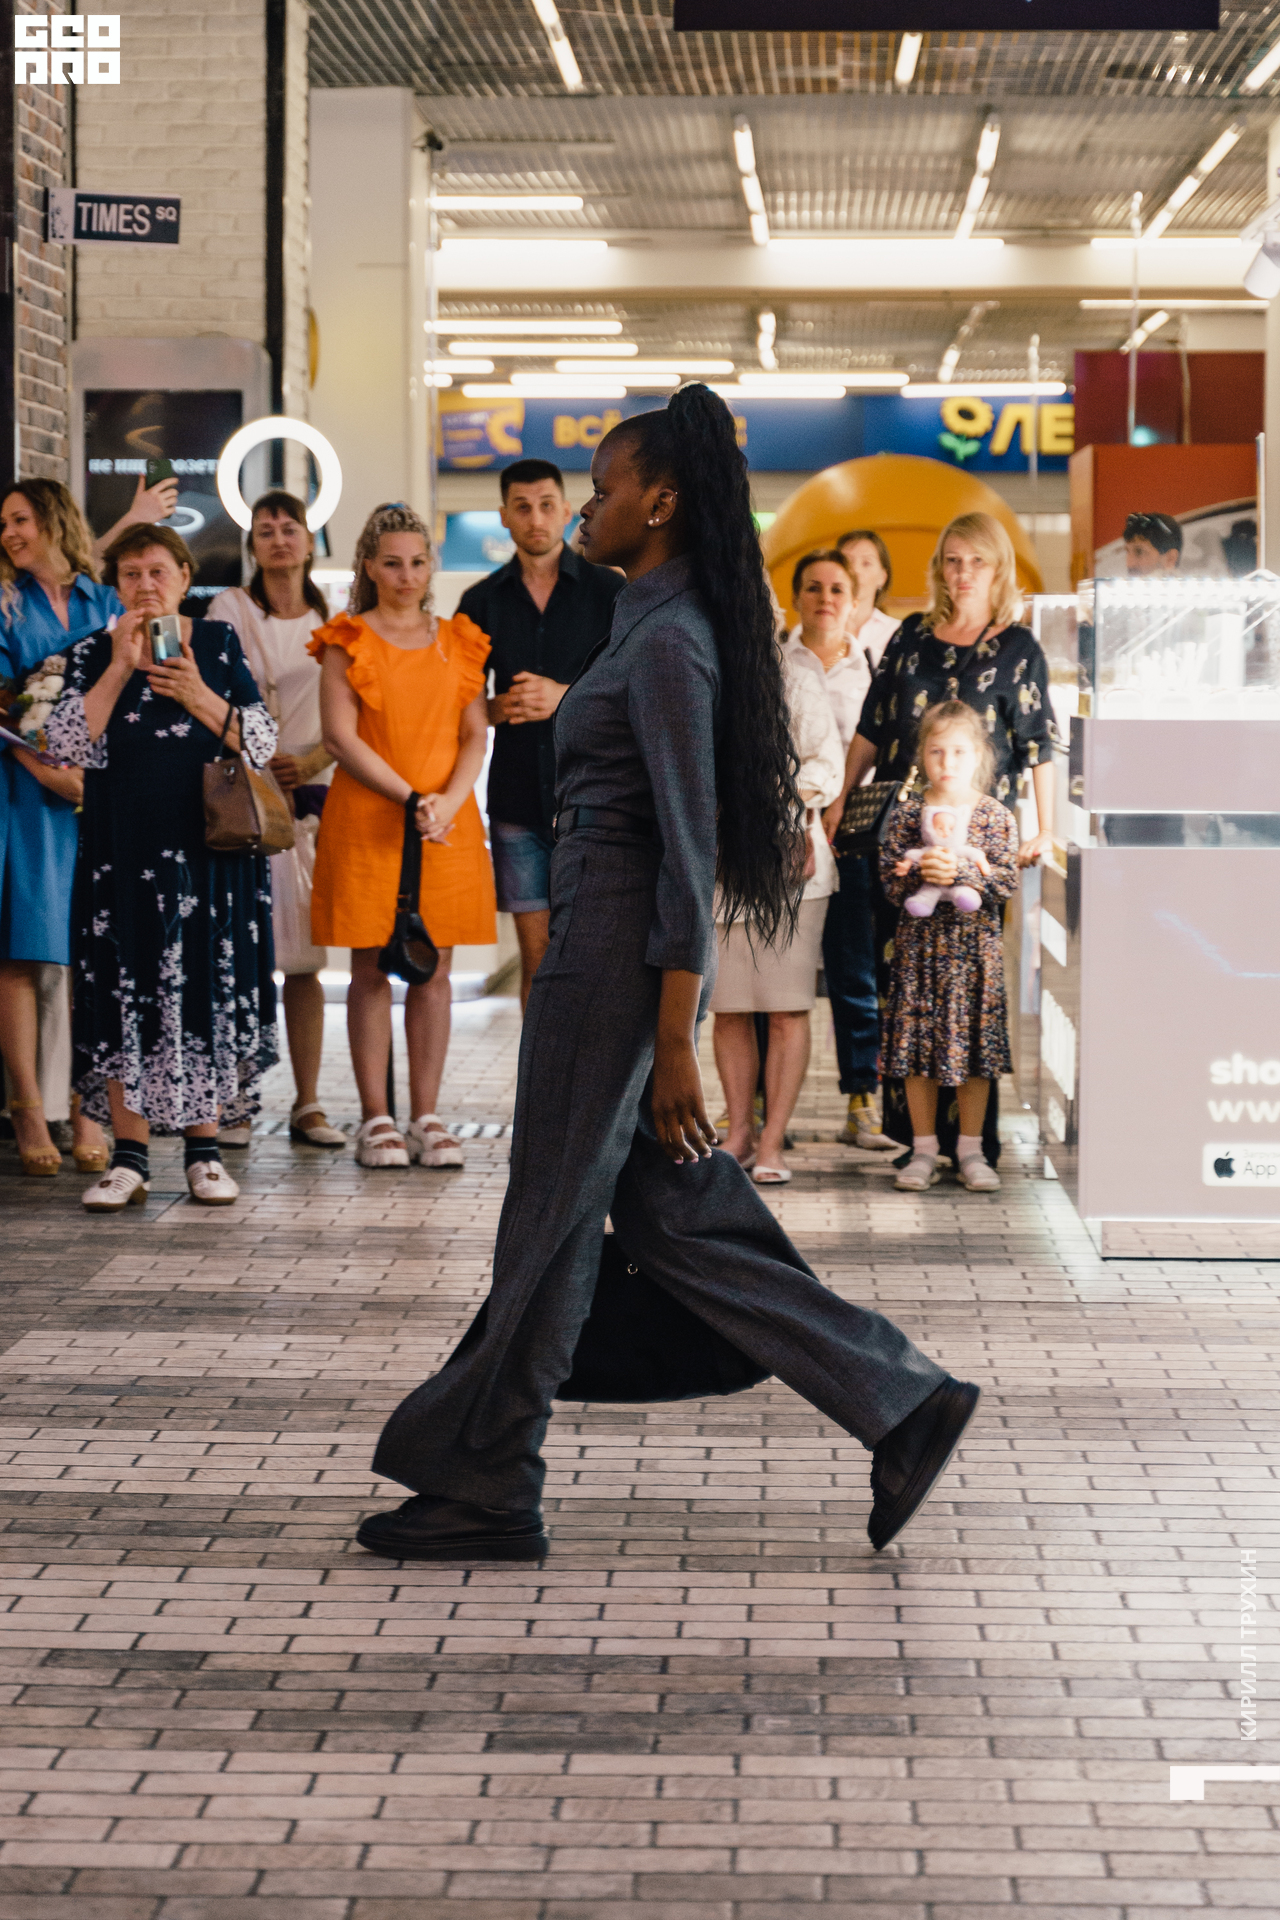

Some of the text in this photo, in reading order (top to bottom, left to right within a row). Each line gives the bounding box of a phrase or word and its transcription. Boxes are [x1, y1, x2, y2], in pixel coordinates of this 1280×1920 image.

[78, 202, 178, 235] TIMES SQ
[1210, 1052, 1280, 1085] sho
[1243, 1161, 1278, 1179] App
